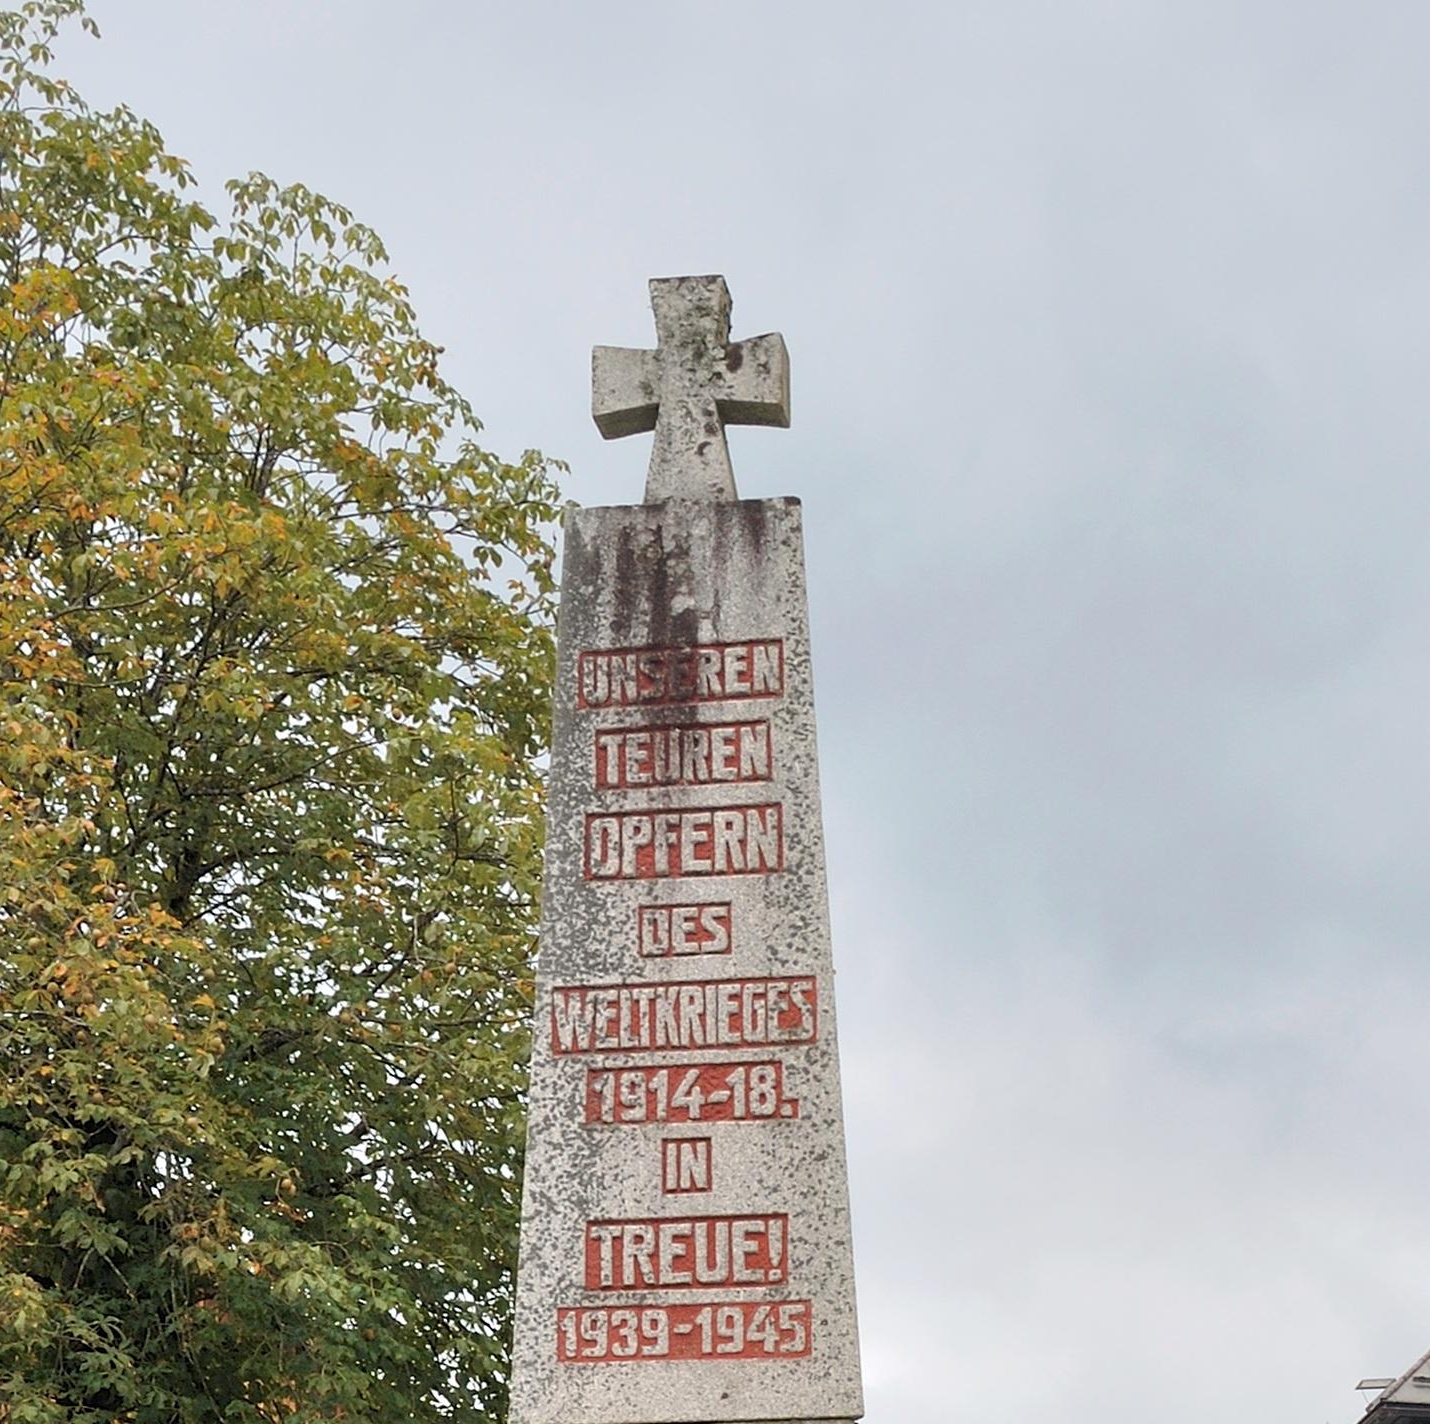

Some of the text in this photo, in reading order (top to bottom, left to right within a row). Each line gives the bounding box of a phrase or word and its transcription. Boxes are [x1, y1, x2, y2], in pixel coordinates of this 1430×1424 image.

[582, 646, 781, 703] UNSEREN
[598, 727, 767, 784] TEUREN
[589, 809, 780, 878] OPFERN
[642, 907, 727, 955] DES
[554, 980, 814, 1051] WELTKRIEGES
[590, 1065, 793, 1122] 1914-18.
[667, 1142, 708, 1191] IN
[590, 1219, 783, 1287] TREUE!
[560, 1305, 807, 1358] 1939-1945
